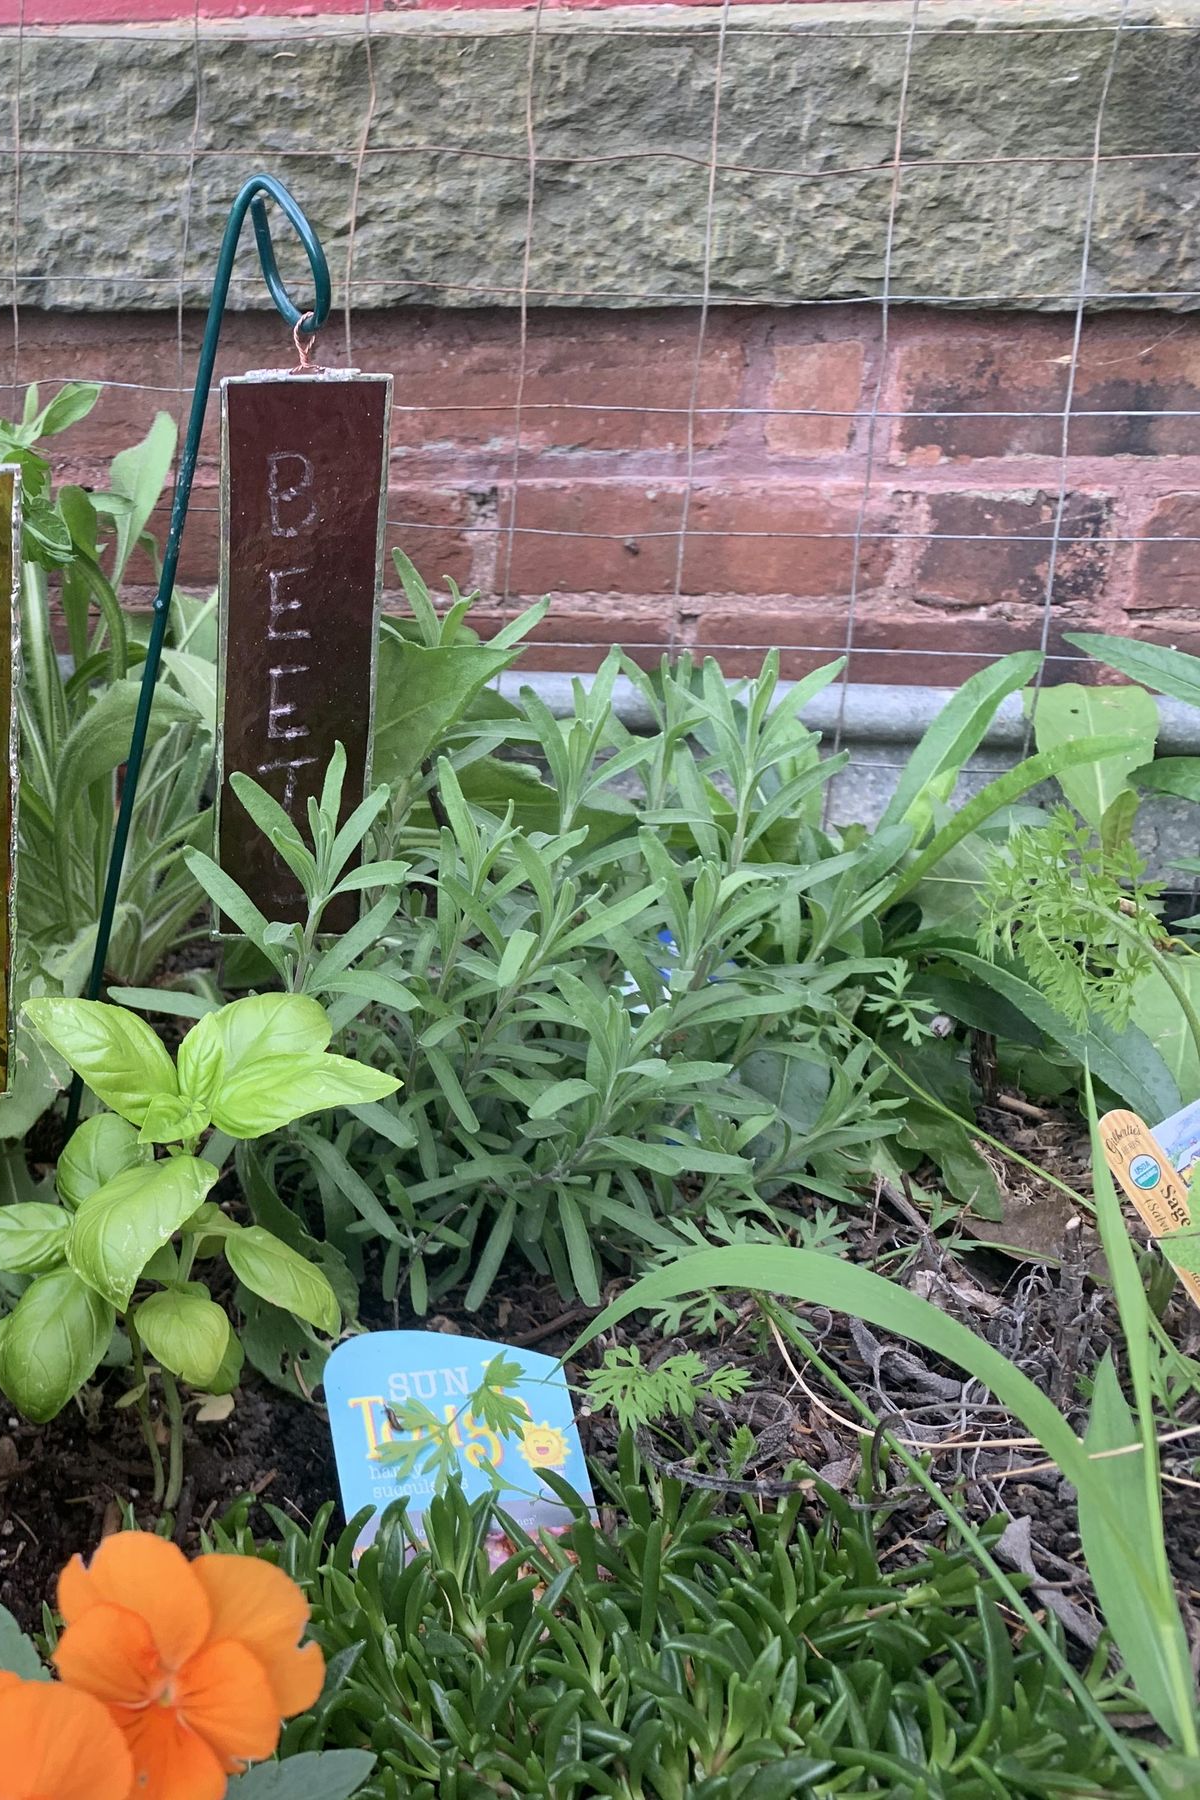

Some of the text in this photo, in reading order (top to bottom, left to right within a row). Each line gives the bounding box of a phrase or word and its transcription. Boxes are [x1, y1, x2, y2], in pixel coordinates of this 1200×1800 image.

[1134, 1161, 1151, 1175] USDA
[1160, 1184, 1191, 1227] Sage
[388, 1366, 470, 1402] SUN
[368, 1463, 423, 1480] hary
